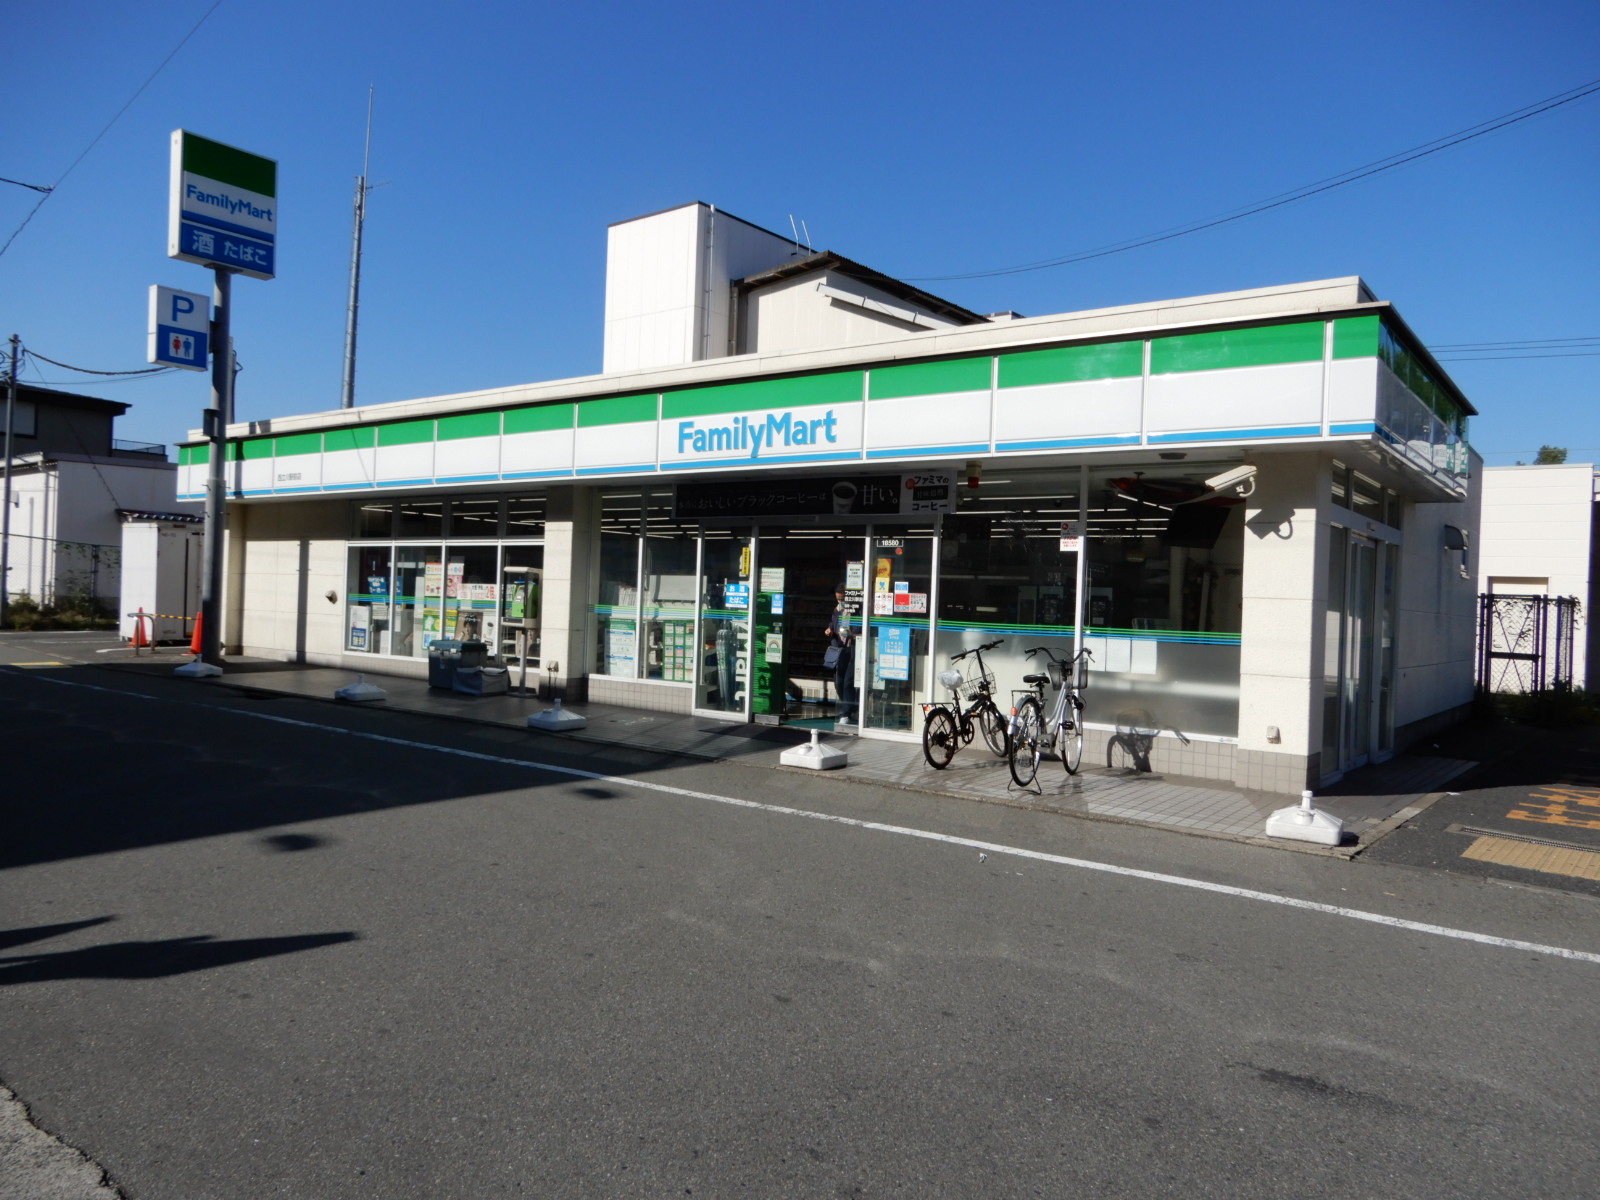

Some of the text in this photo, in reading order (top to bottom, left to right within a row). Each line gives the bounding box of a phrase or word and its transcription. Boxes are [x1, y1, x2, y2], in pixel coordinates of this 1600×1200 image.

[186, 184, 273, 222] FamilyMart
[192, 229, 268, 266] 酒 たばこ
[171, 294, 195, 322] P
[678, 410, 837, 458] FamilyMart
[911, 502, 948, 511] コーヒー
